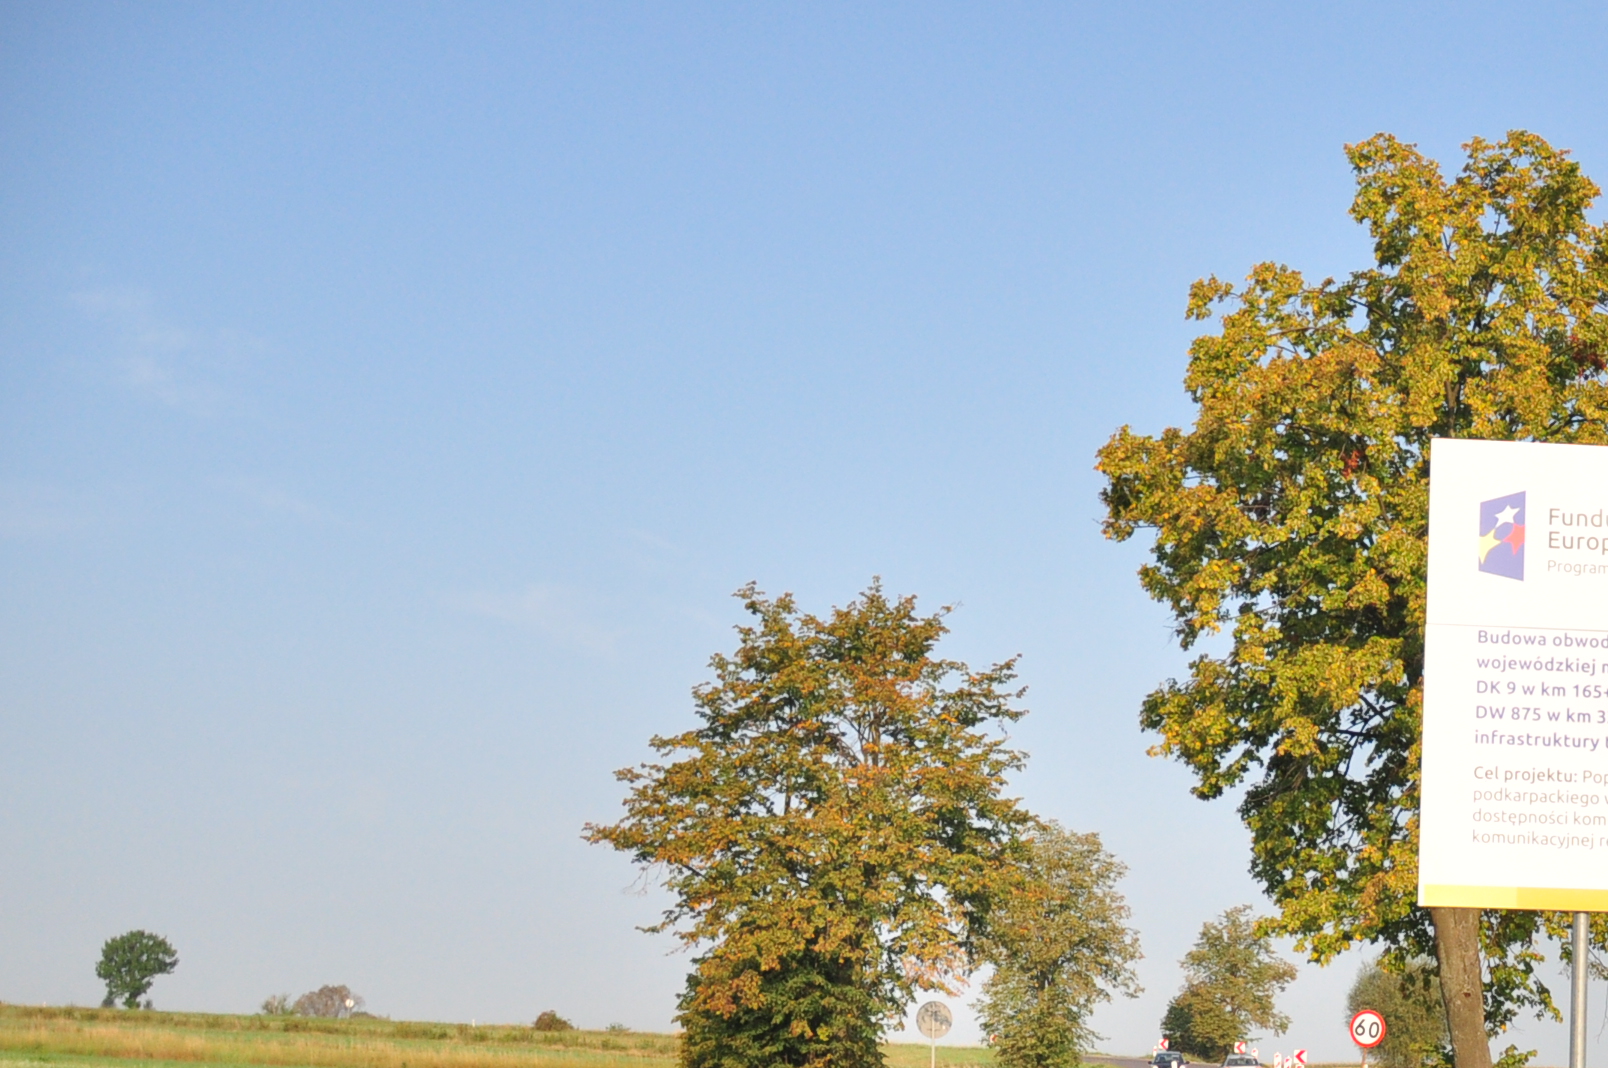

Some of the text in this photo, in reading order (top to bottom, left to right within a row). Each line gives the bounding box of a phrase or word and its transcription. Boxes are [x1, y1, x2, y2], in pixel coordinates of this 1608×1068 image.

[1478, 630, 1546, 646] Budowa
[1476, 655, 1596, 677] wojewódzkiej
[1476, 680, 1501, 694] DK
[1506, 681, 1516, 695] 9
[1521, 685, 1536, 696] w
[1541, 681, 1566, 697] km
[1475, 705, 1506, 720] DW
[1511, 706, 1541, 722] 875
[1547, 711, 1561, 722] w
[1566, 707, 1591, 723] km
[1475, 729, 1600, 752] infrastruktury
[1473, 765, 1499, 780] Cel
[1503, 767, 1578, 785] projektu:
[1473, 787, 1600, 808] podkarpackiego
[1472, 807, 1568, 826] dostępności
[1472, 828, 1595, 850] komunikacyjnej
[1354, 1018, 1380, 1039] 60
